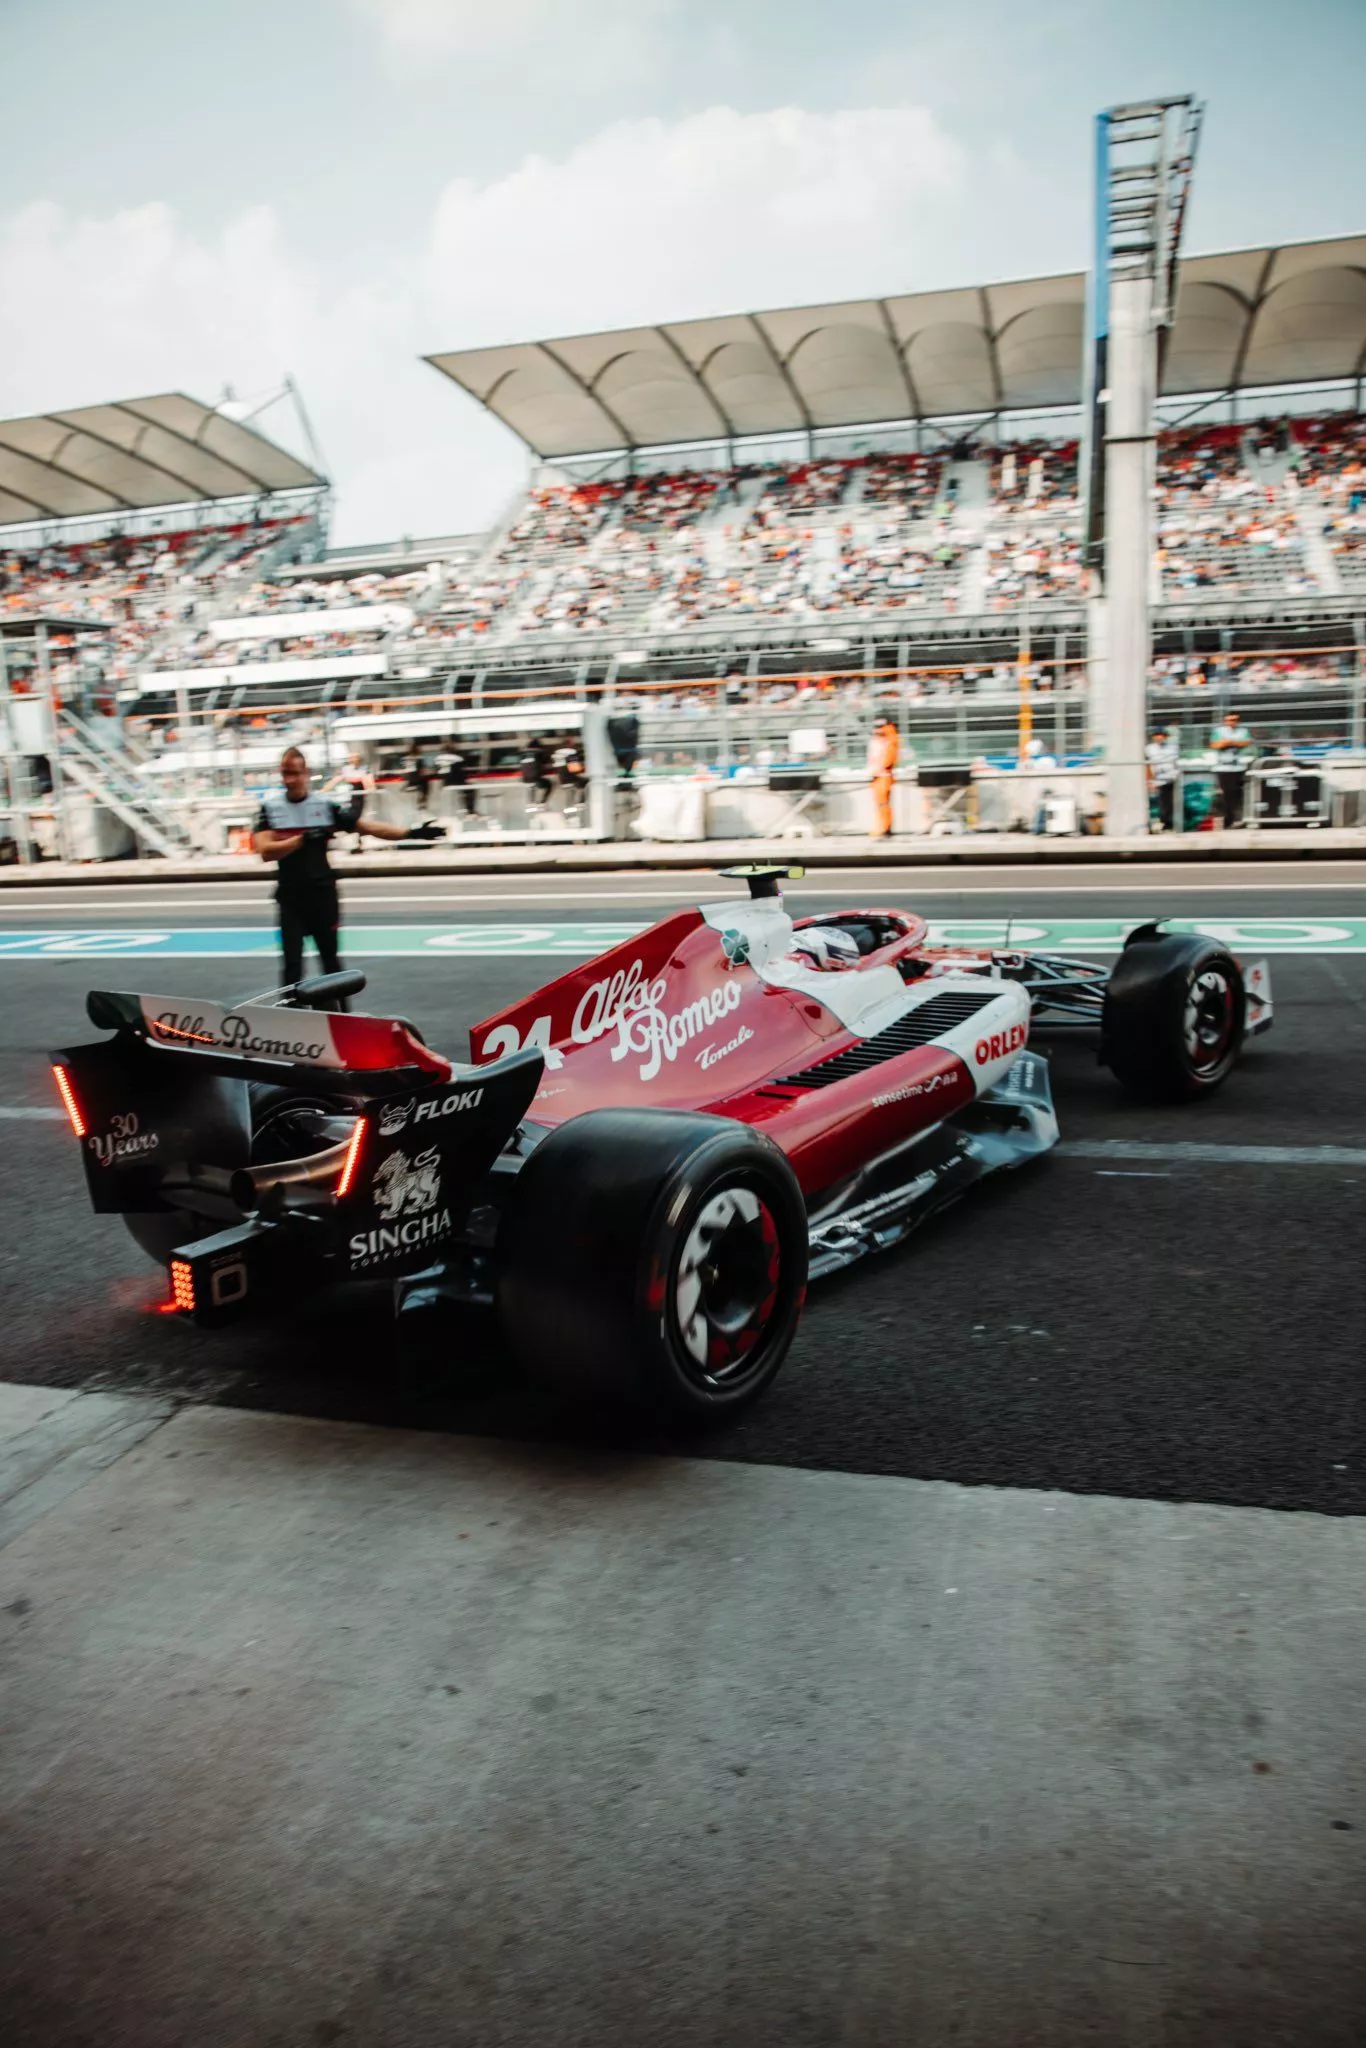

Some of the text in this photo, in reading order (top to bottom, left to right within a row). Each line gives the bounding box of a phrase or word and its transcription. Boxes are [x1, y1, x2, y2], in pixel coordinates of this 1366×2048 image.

[571, 959, 667, 1055] Alfa
[153, 1013, 326, 1059] Alfa Romeo
[482, 1015, 566, 1070] 24
[624, 980, 741, 1081] Romeo
[695, 1025, 754, 1070] Tonale
[111, 1112, 138, 1138] 30
[413, 1088, 485, 1124] FLOKI
[88, 1132, 159, 1167] Years
[349, 1208, 452, 1260] SINGHA
